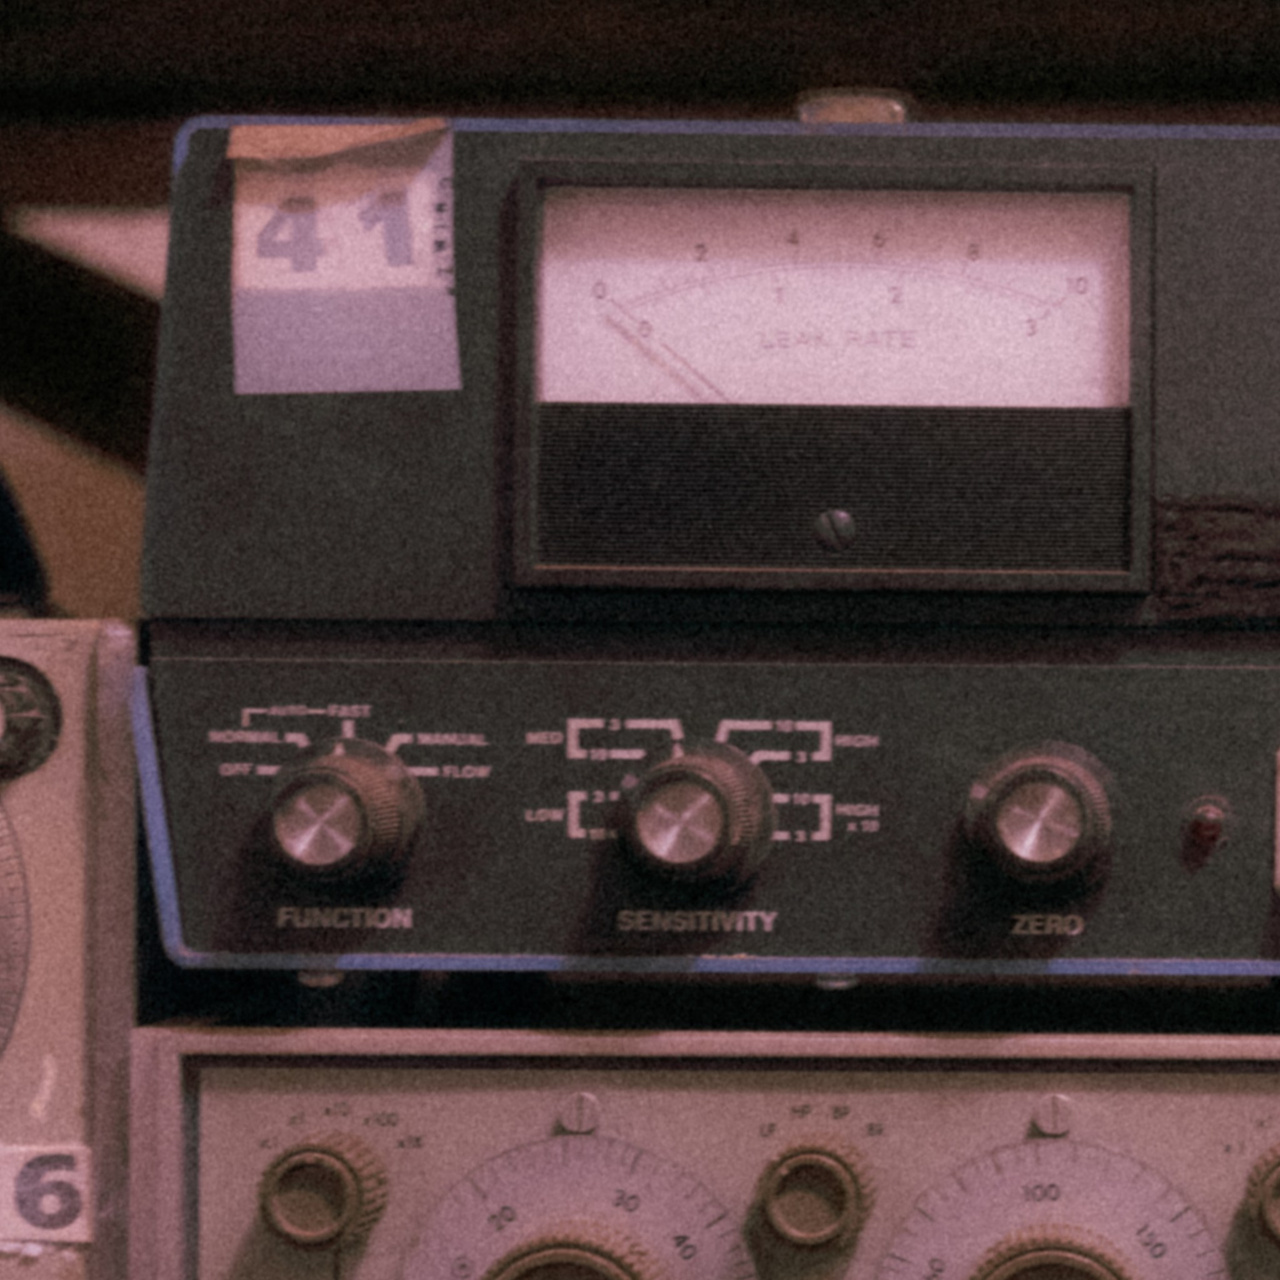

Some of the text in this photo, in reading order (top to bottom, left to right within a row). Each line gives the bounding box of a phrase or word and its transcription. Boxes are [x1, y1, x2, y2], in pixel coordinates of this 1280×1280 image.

[257, 188, 414, 274] 41
[328, 704, 372, 718] FAST
[442, 765, 492, 779] FLOW
[524, 808, 565, 823] LOW
[275, 906, 414, 929] FUNCTION
[616, 910, 779, 932] SENSITIVITY
[1010, 914, 1086, 936] ZERO
[14, 1153, 83, 1231] 6
[1021, 1182, 1062, 1203] 100
